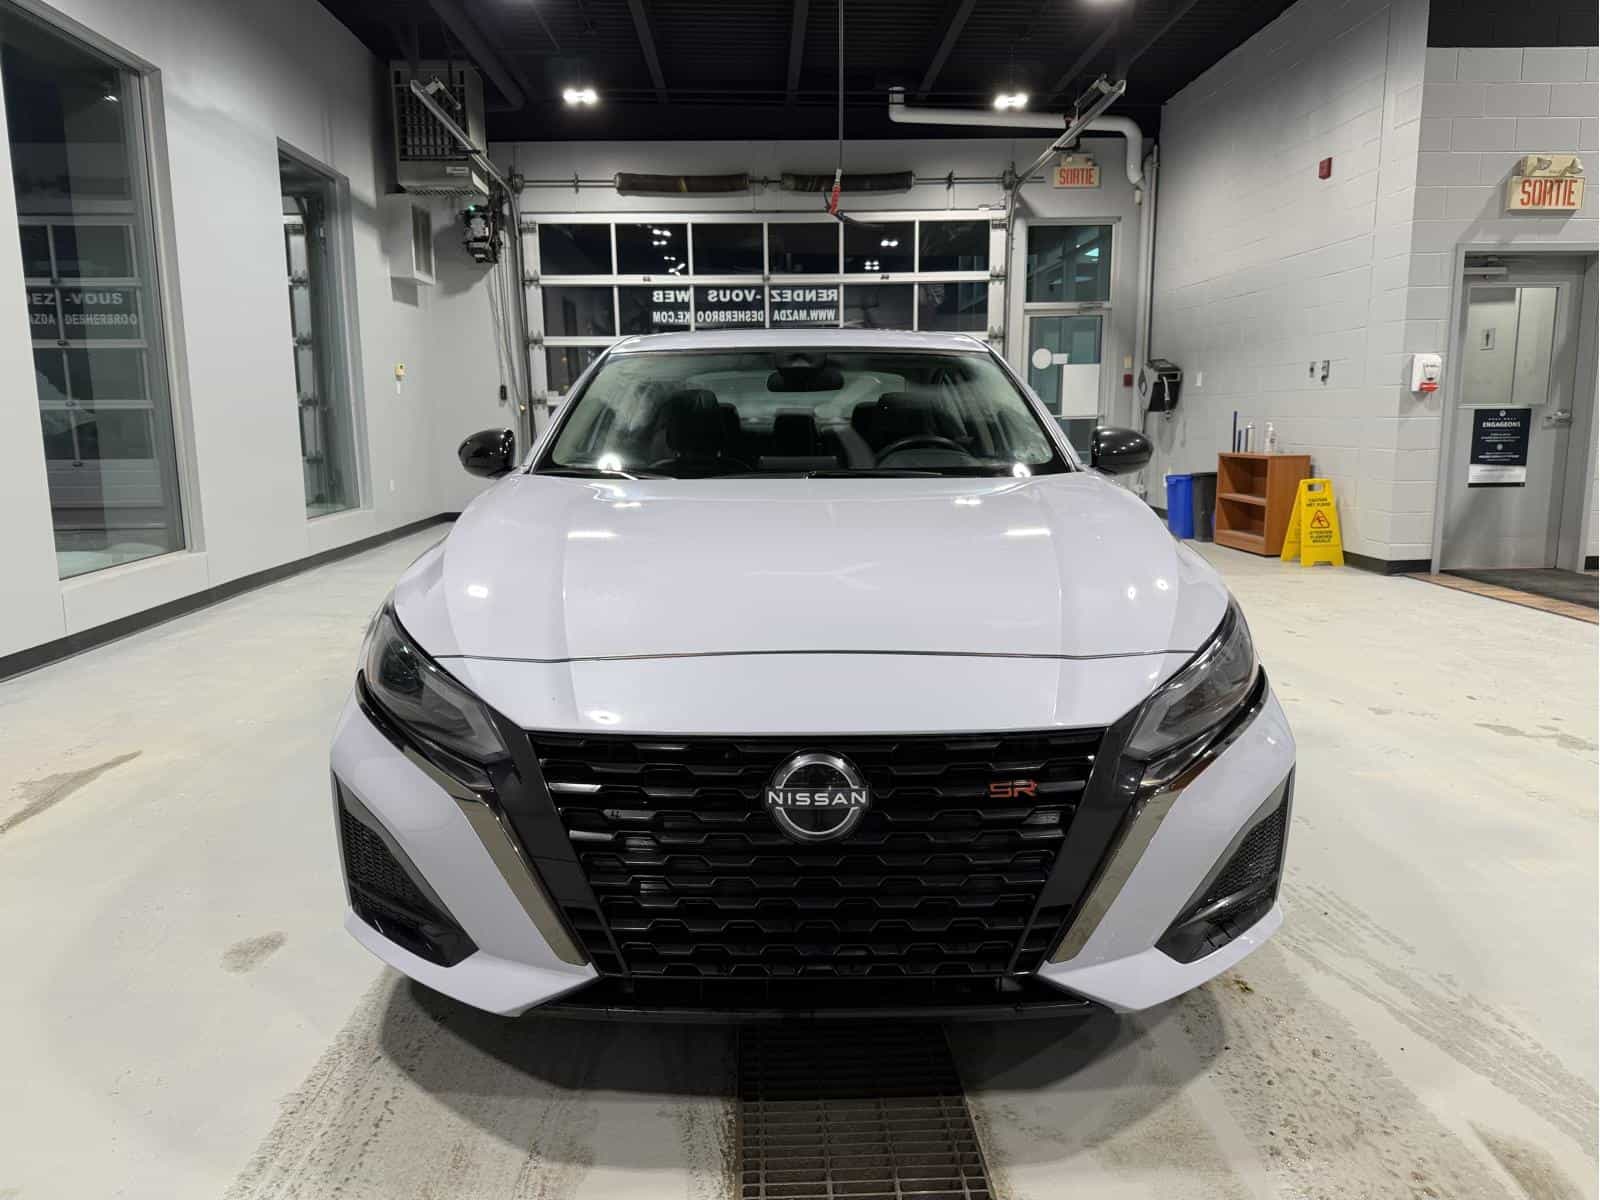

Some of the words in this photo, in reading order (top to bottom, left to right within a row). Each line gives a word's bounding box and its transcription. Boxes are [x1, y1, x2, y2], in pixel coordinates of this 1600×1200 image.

[1060, 168, 1095, 185] SORTIE
[1520, 179, 1578, 207] SORTIE
[988, 780, 1039, 798] SR
[768, 790, 867, 806] NISSAN
